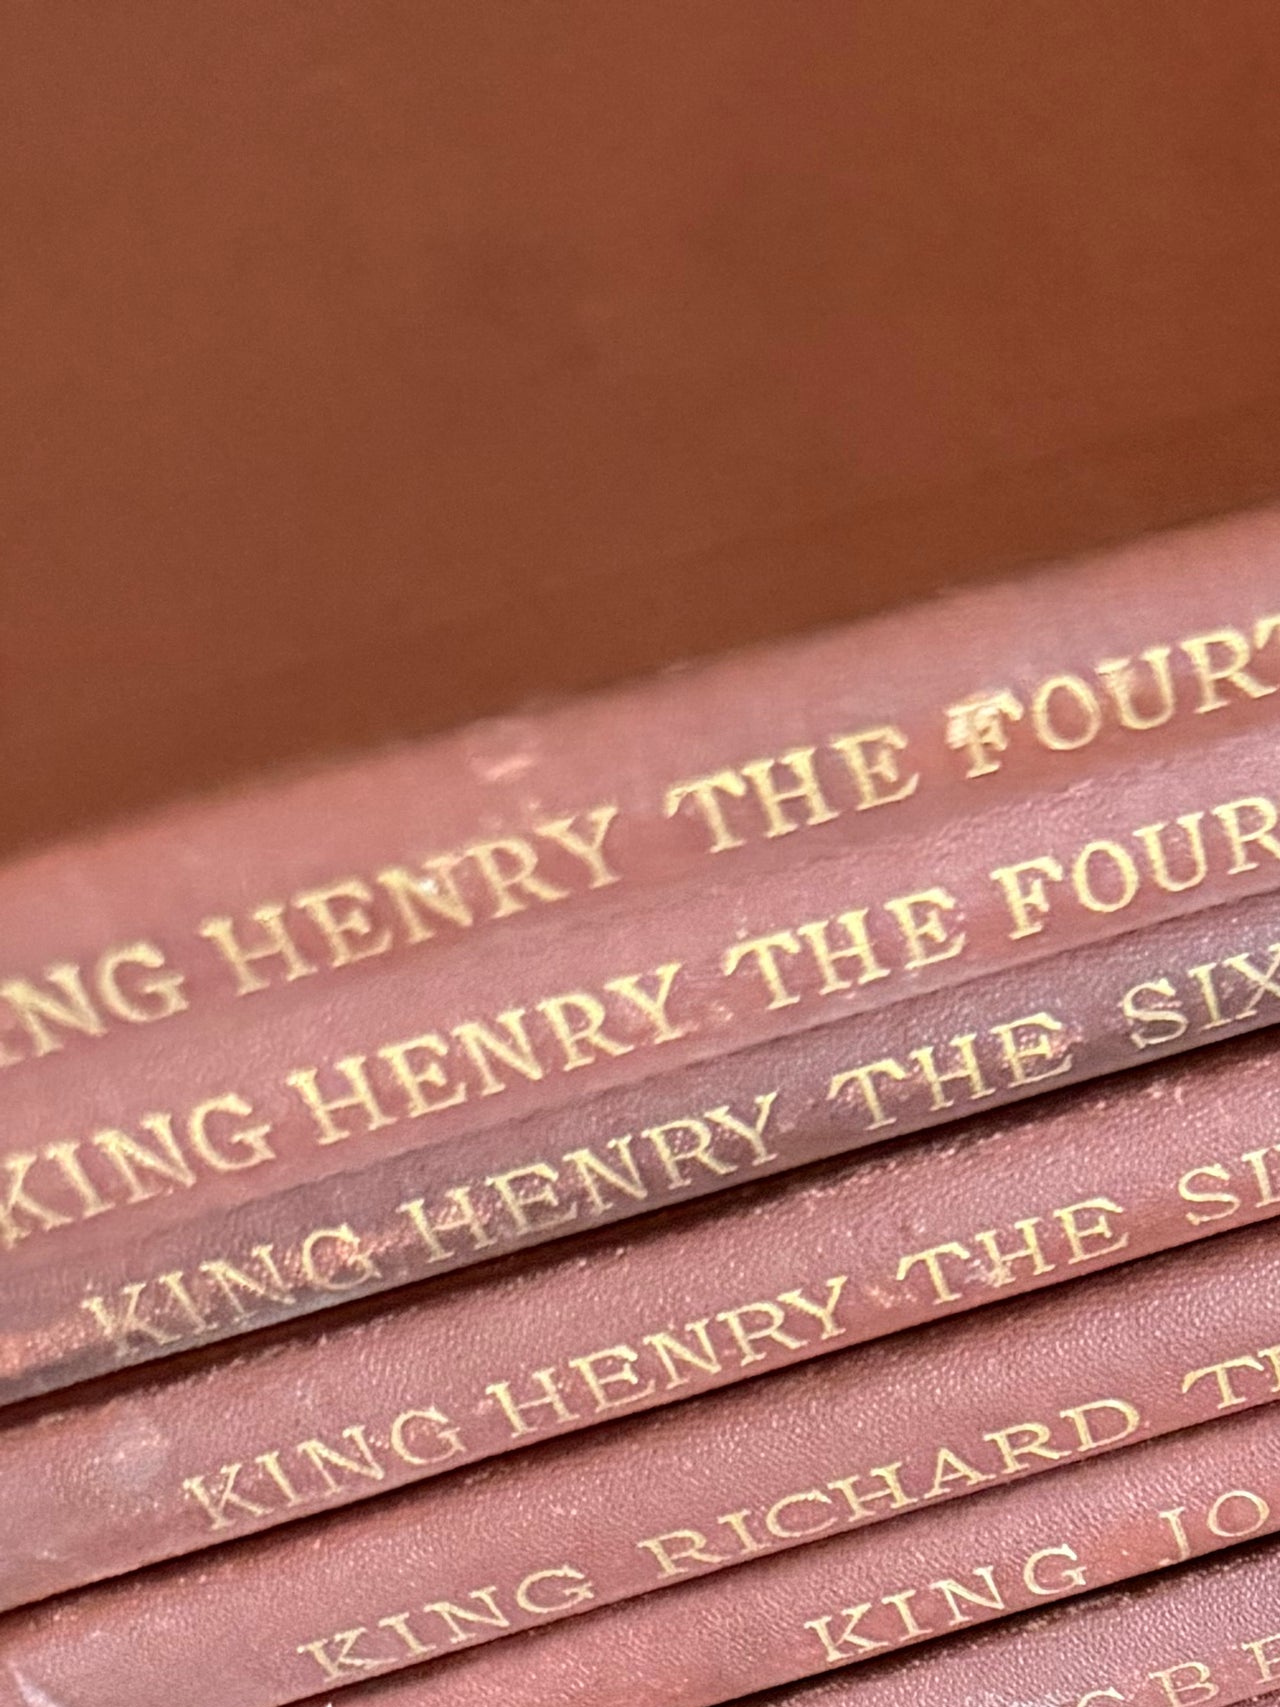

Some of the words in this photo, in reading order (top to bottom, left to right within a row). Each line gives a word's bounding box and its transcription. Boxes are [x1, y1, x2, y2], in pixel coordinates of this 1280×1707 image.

[0, 941, 188, 1068] NG
[199, 806, 622, 997] HENRY
[664, 722, 920, 854] THE
[0, 1092, 277, 1248] KING
[285, 962, 684, 1146] HENRY
[724, 885, 968, 1011] THE
[79, 1221, 382, 1358] KING
[400, 1091, 782, 1264] HENRY
[826, 1009, 1075, 1131] THE
[183, 1404, 468, 1534] KING
[485, 1275, 849, 1438] HENRY
[895, 1196, 1128, 1307] THE
[296, 1565, 595, 1682] KING
[637, 1398, 1141, 1579] RICHARD
[804, 1543, 1087, 1663] KING
